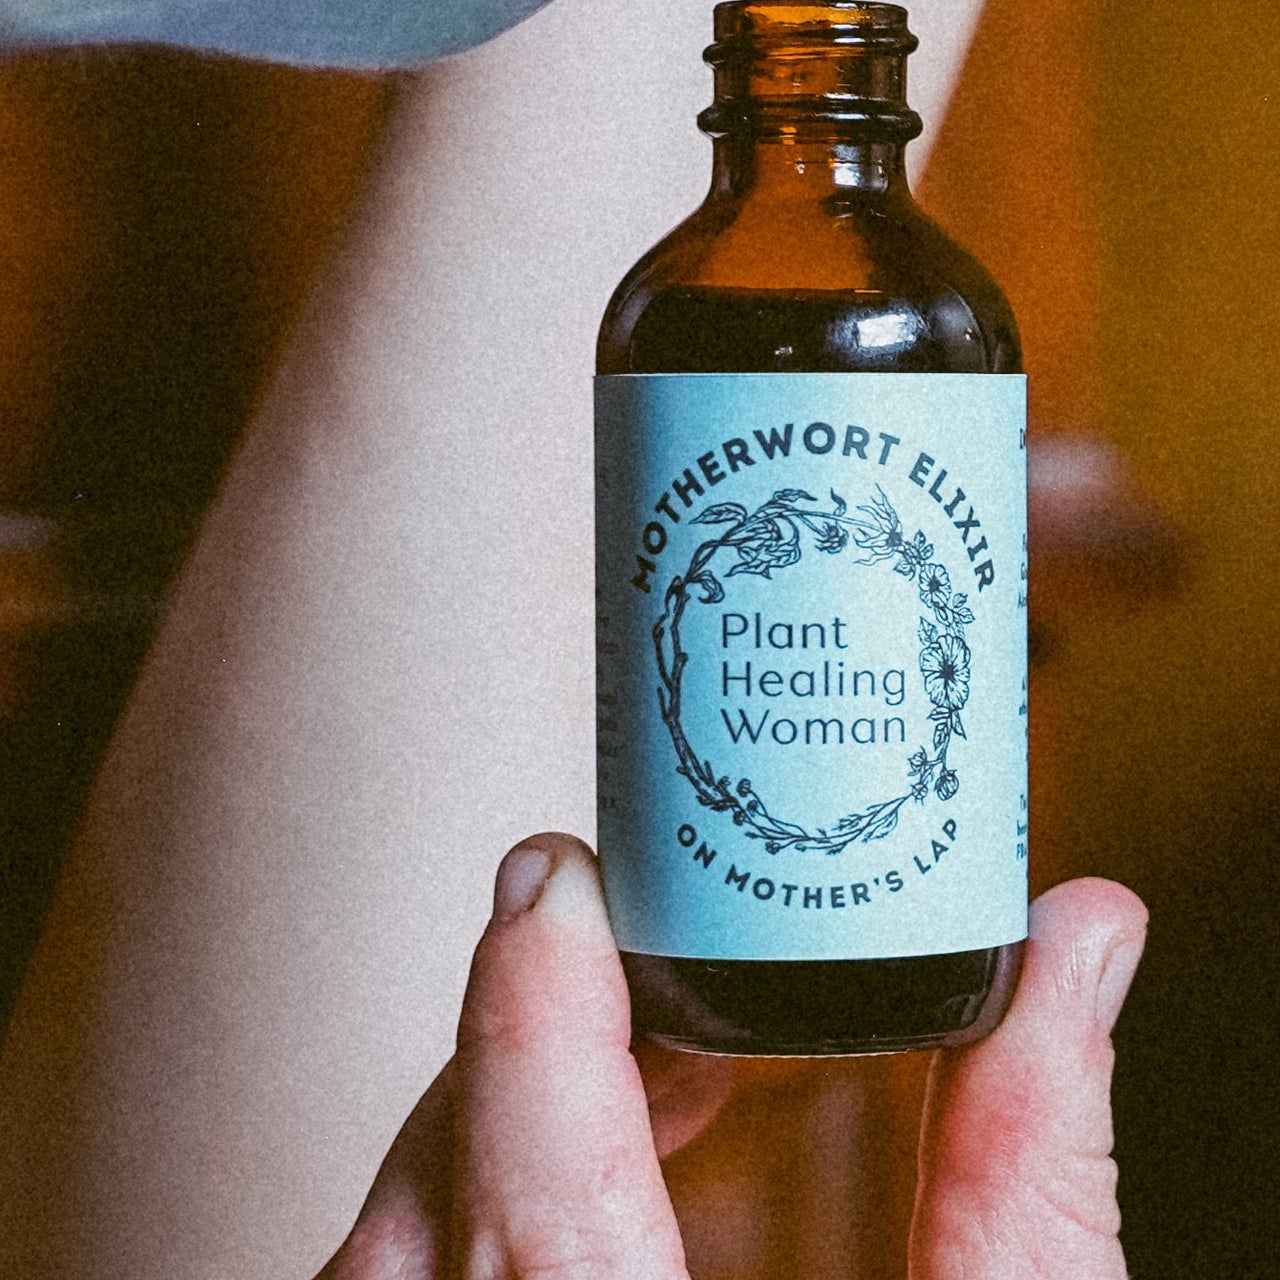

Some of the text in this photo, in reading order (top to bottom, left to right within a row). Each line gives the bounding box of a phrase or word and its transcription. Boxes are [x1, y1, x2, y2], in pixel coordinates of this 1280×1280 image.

[630, 421, 995, 594] MOTHERWORT ELIXIR
[721, 612, 848, 649] Plant
[721, 661, 906, 705] Healing
[720, 709, 906, 745] Woman
[677, 818, 957, 909] ON MOTHER'S LAP
